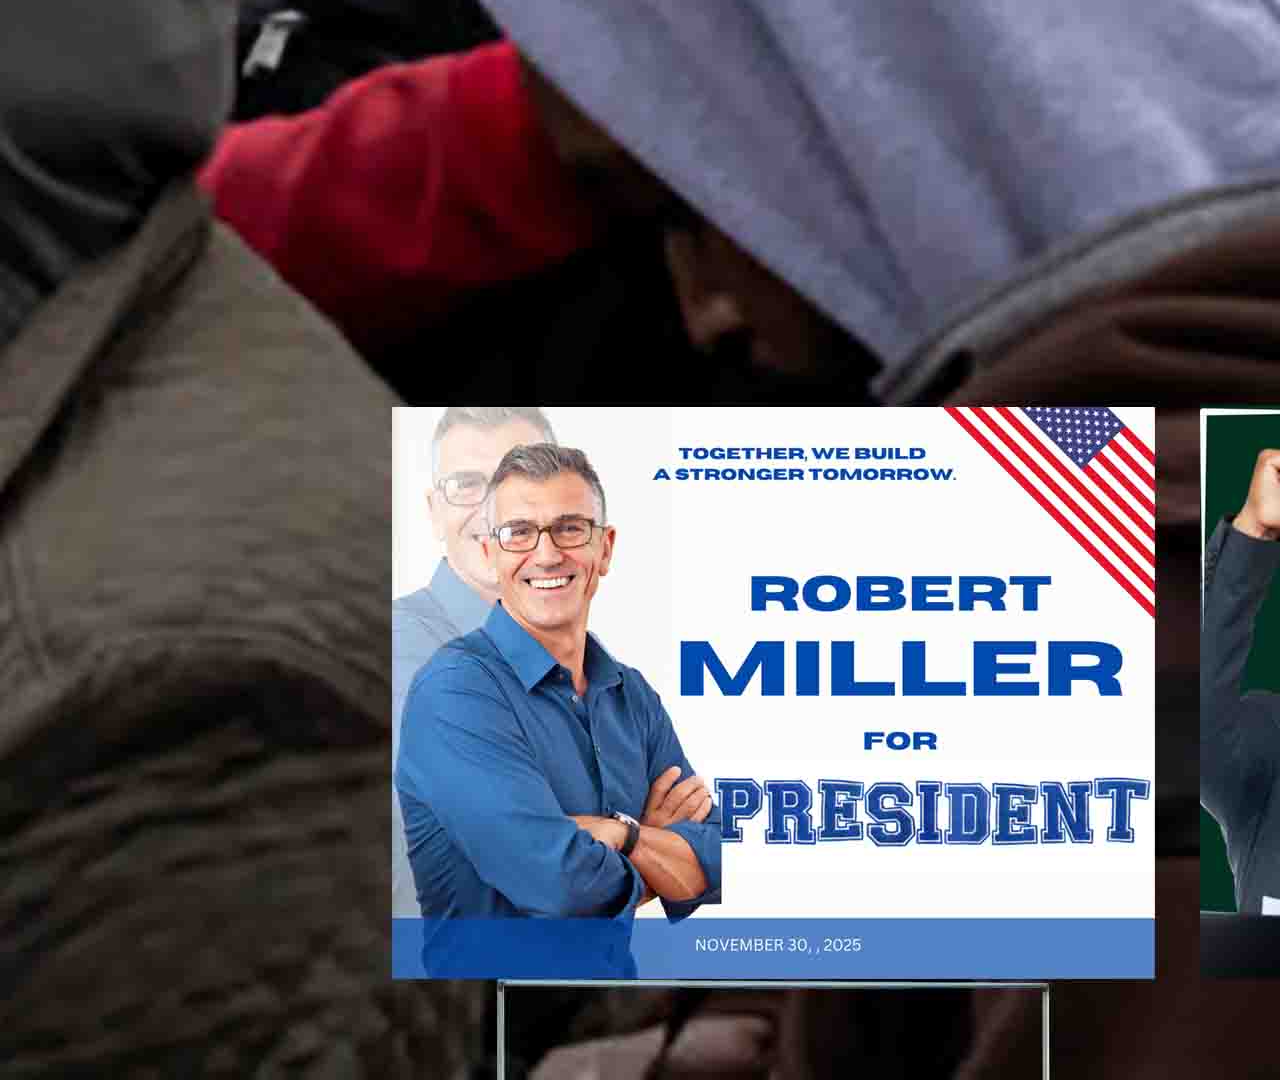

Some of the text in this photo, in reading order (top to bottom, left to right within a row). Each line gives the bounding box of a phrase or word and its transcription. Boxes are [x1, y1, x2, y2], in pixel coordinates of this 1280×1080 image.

[678, 447, 927, 463] TOGETHER, WE BUILD
[652, 468, 957, 481] A STRONGER TOMORROW.
[751, 575, 1052, 612] ROBERT
[680, 640, 1123, 697] MILLER
[863, 731, 938, 751] FOR
[713, 777, 1151, 848] PRESIDENT
[695, 938, 784, 952] NOVEMBER
[823, 938, 862, 952] 2025
